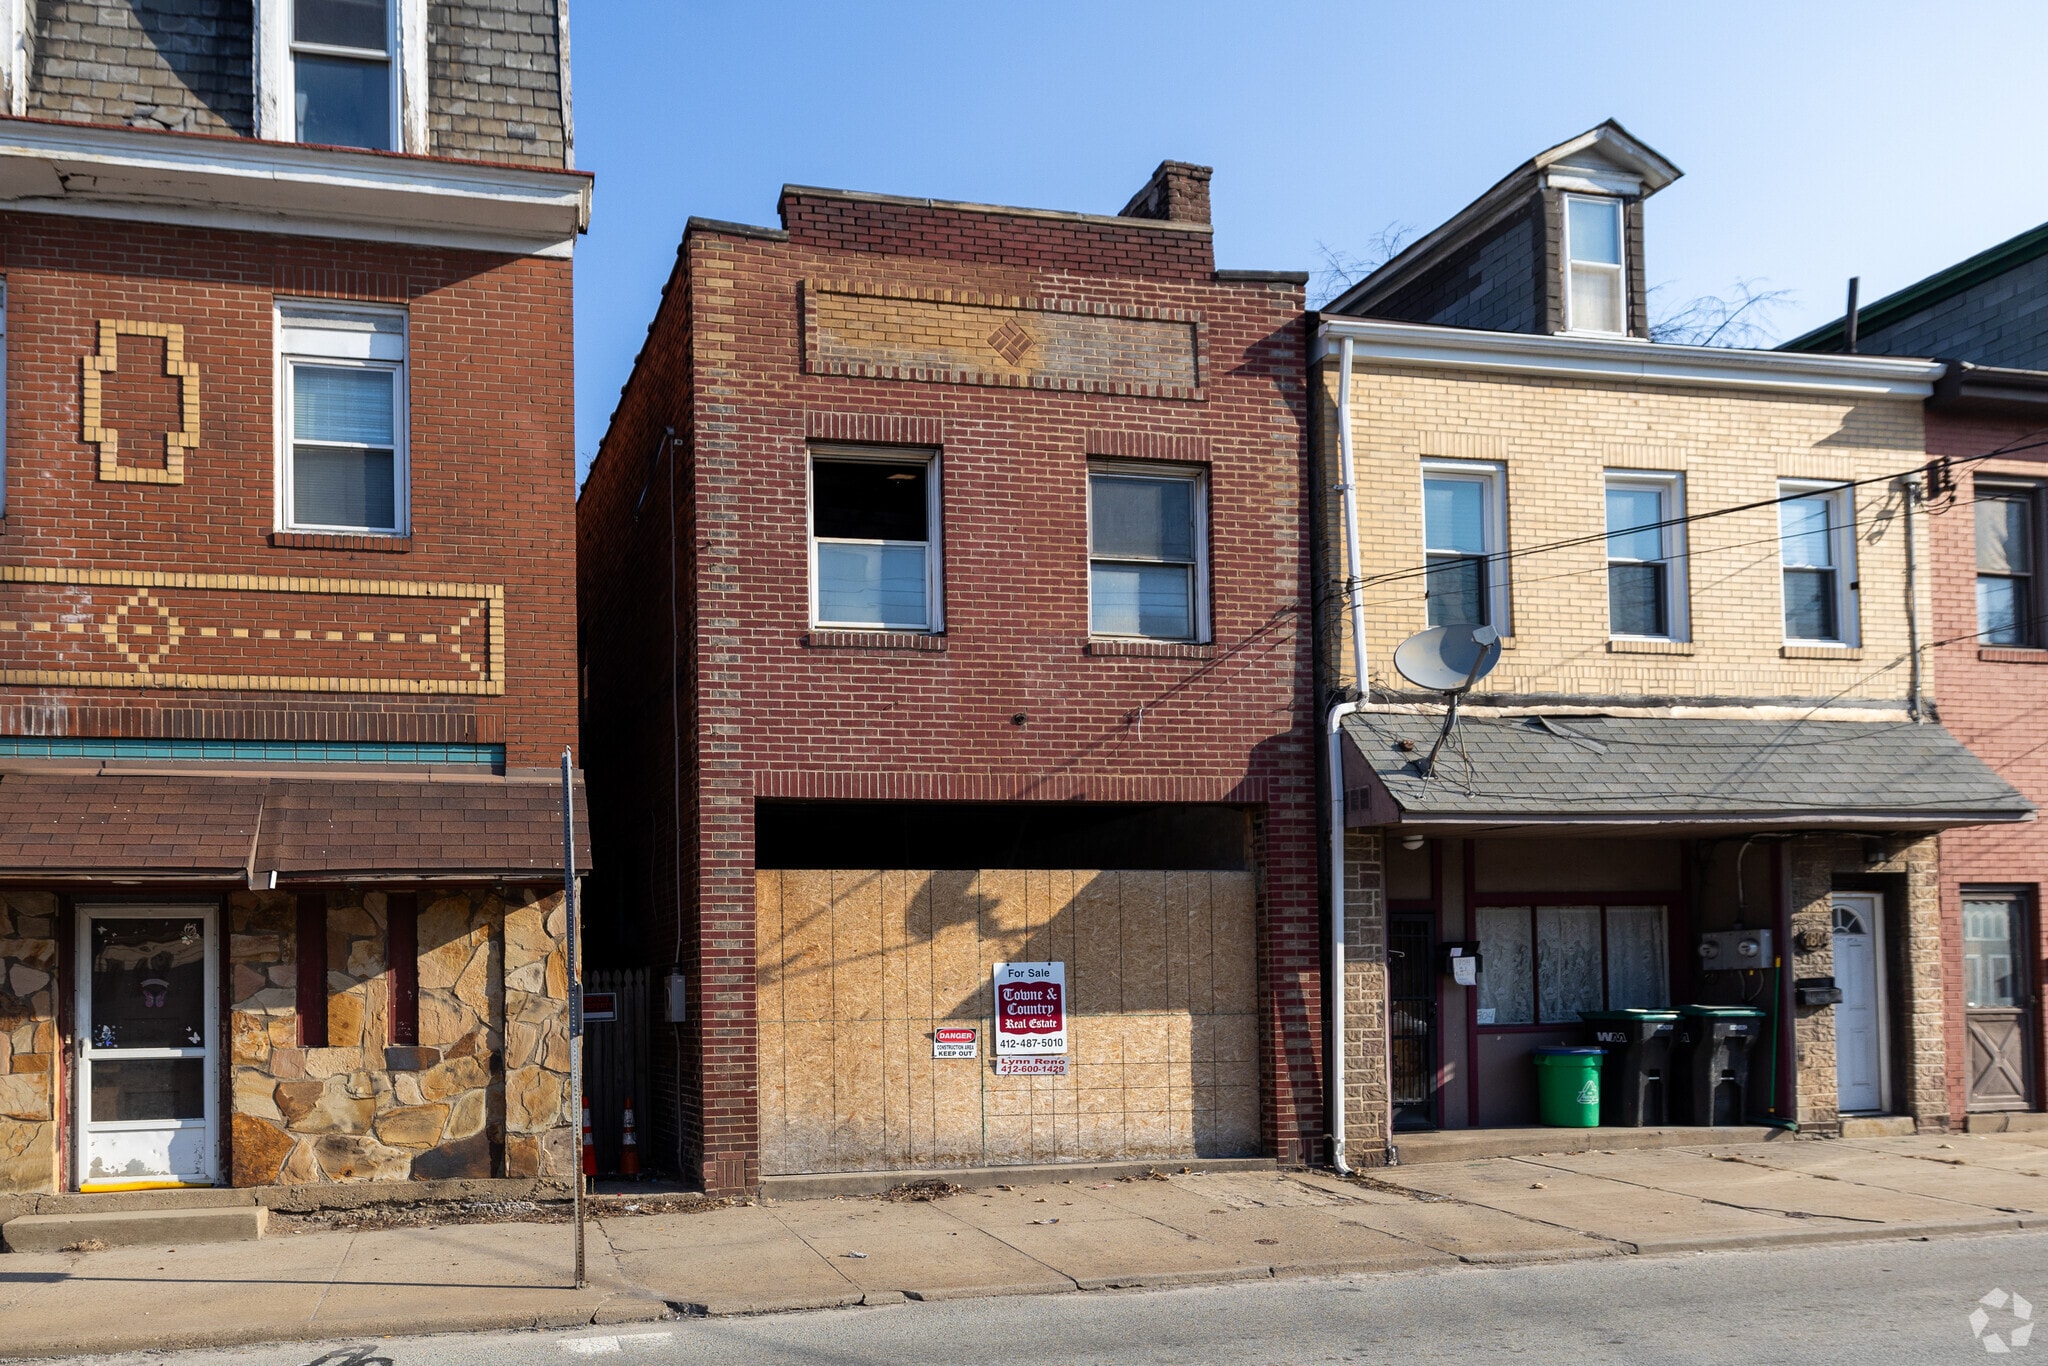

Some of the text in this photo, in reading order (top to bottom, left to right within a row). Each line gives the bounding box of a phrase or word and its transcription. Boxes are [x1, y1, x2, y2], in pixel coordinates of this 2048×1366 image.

[1008, 968, 1050, 977] For Sale
[1002, 987, 1058, 1001] Towne &
[1007, 1002, 1054, 1017] Country
[1005, 1018, 1058, 1029] Real Estate
[1597, 1032, 1627, 1043] WM
[1000, 1038, 1063, 1048] 412-487-5010
[1001, 1058, 1030, 1066] Lynn
[1001, 1065, 1065, 1073] 412-600-1429
